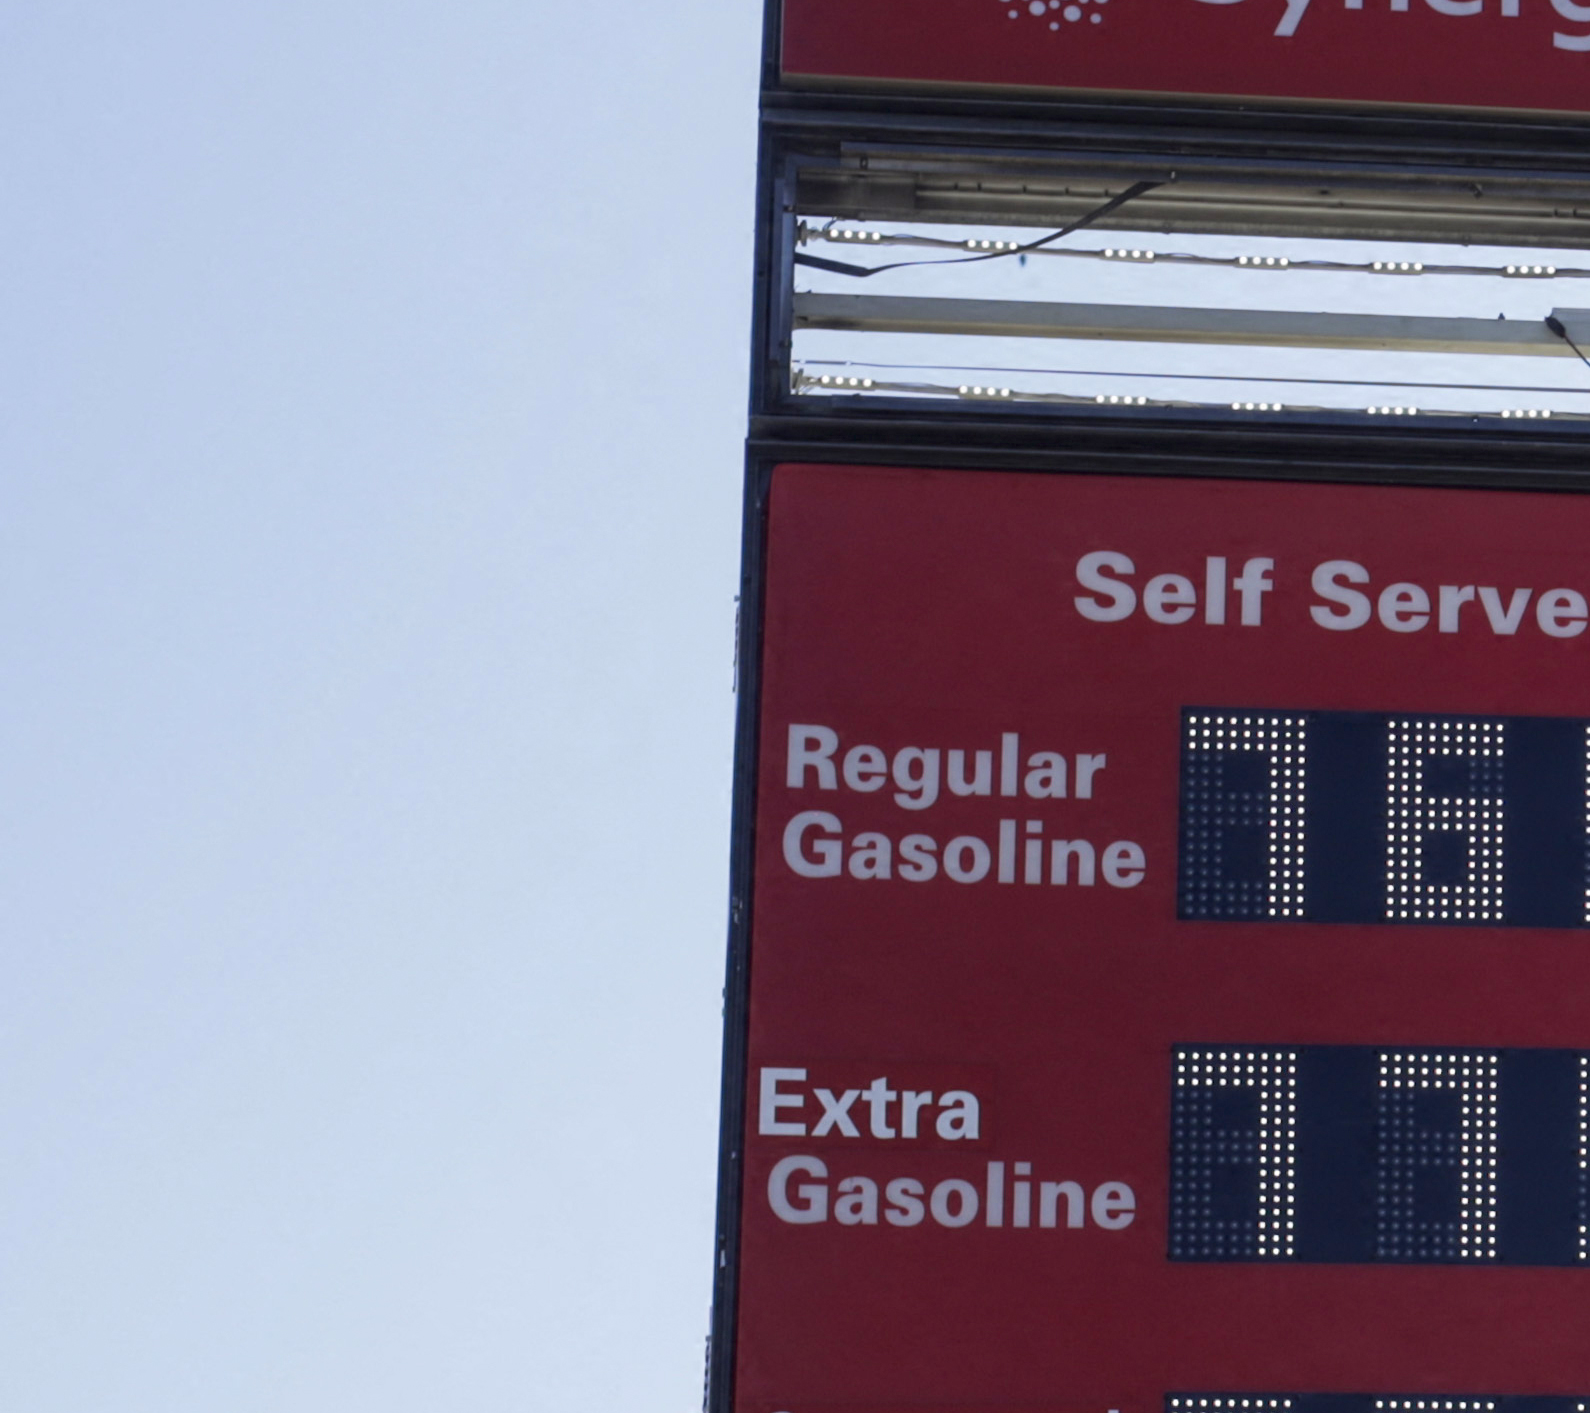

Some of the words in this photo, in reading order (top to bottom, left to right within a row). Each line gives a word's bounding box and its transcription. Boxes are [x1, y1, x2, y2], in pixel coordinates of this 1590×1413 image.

[1075, 551, 1273, 626] Self
[1310, 560, 1588, 637] Serve
[787, 724, 1105, 812] Regular
[783, 811, 1145, 888] Gasoline
[759, 1068, 979, 1140] Extra
[768, 1155, 1135, 1229] Gasoline
